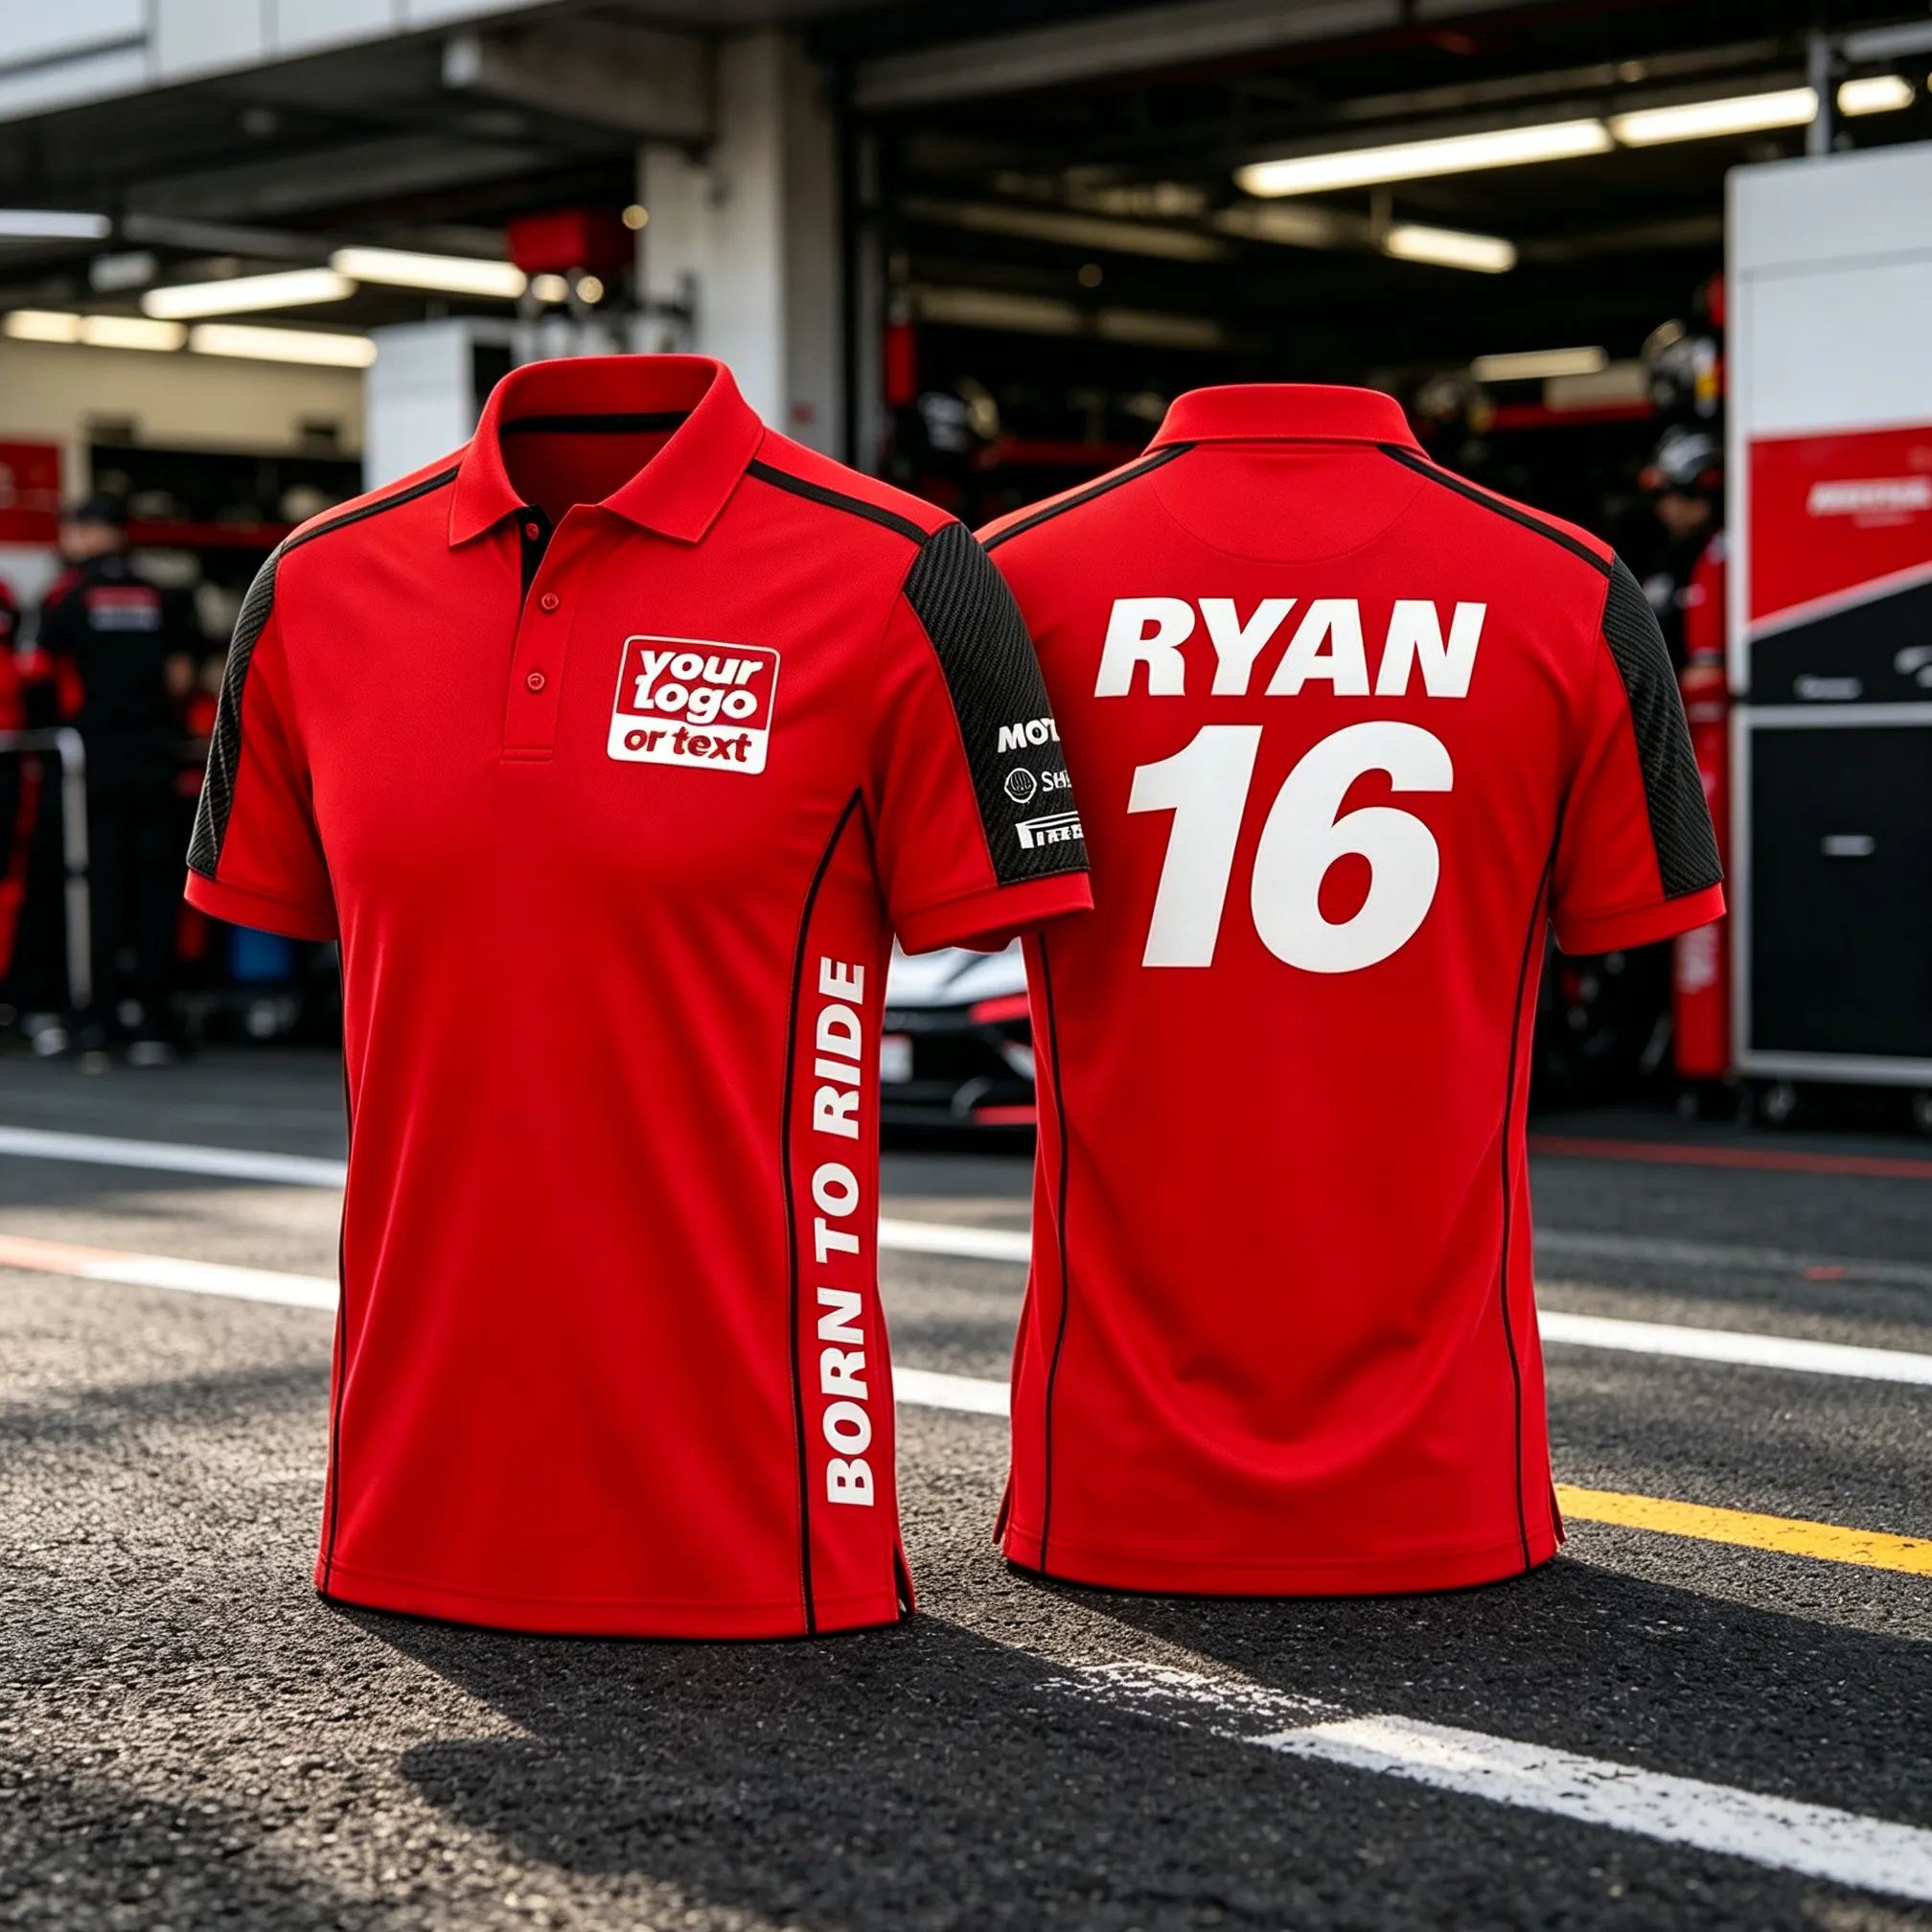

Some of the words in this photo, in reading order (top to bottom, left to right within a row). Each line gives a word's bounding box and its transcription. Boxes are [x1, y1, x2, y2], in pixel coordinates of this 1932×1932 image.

[634, 650, 764, 687] your
[1094, 597, 1487, 699] RYAN
[624, 728, 667, 752] or
[671, 726, 752, 763] text
[1127, 721, 1454, 974] 16
[813, 956, 865, 1140] RIDE
[811, 1162, 861, 1264] TO
[816, 1286, 875, 1507] BORN
